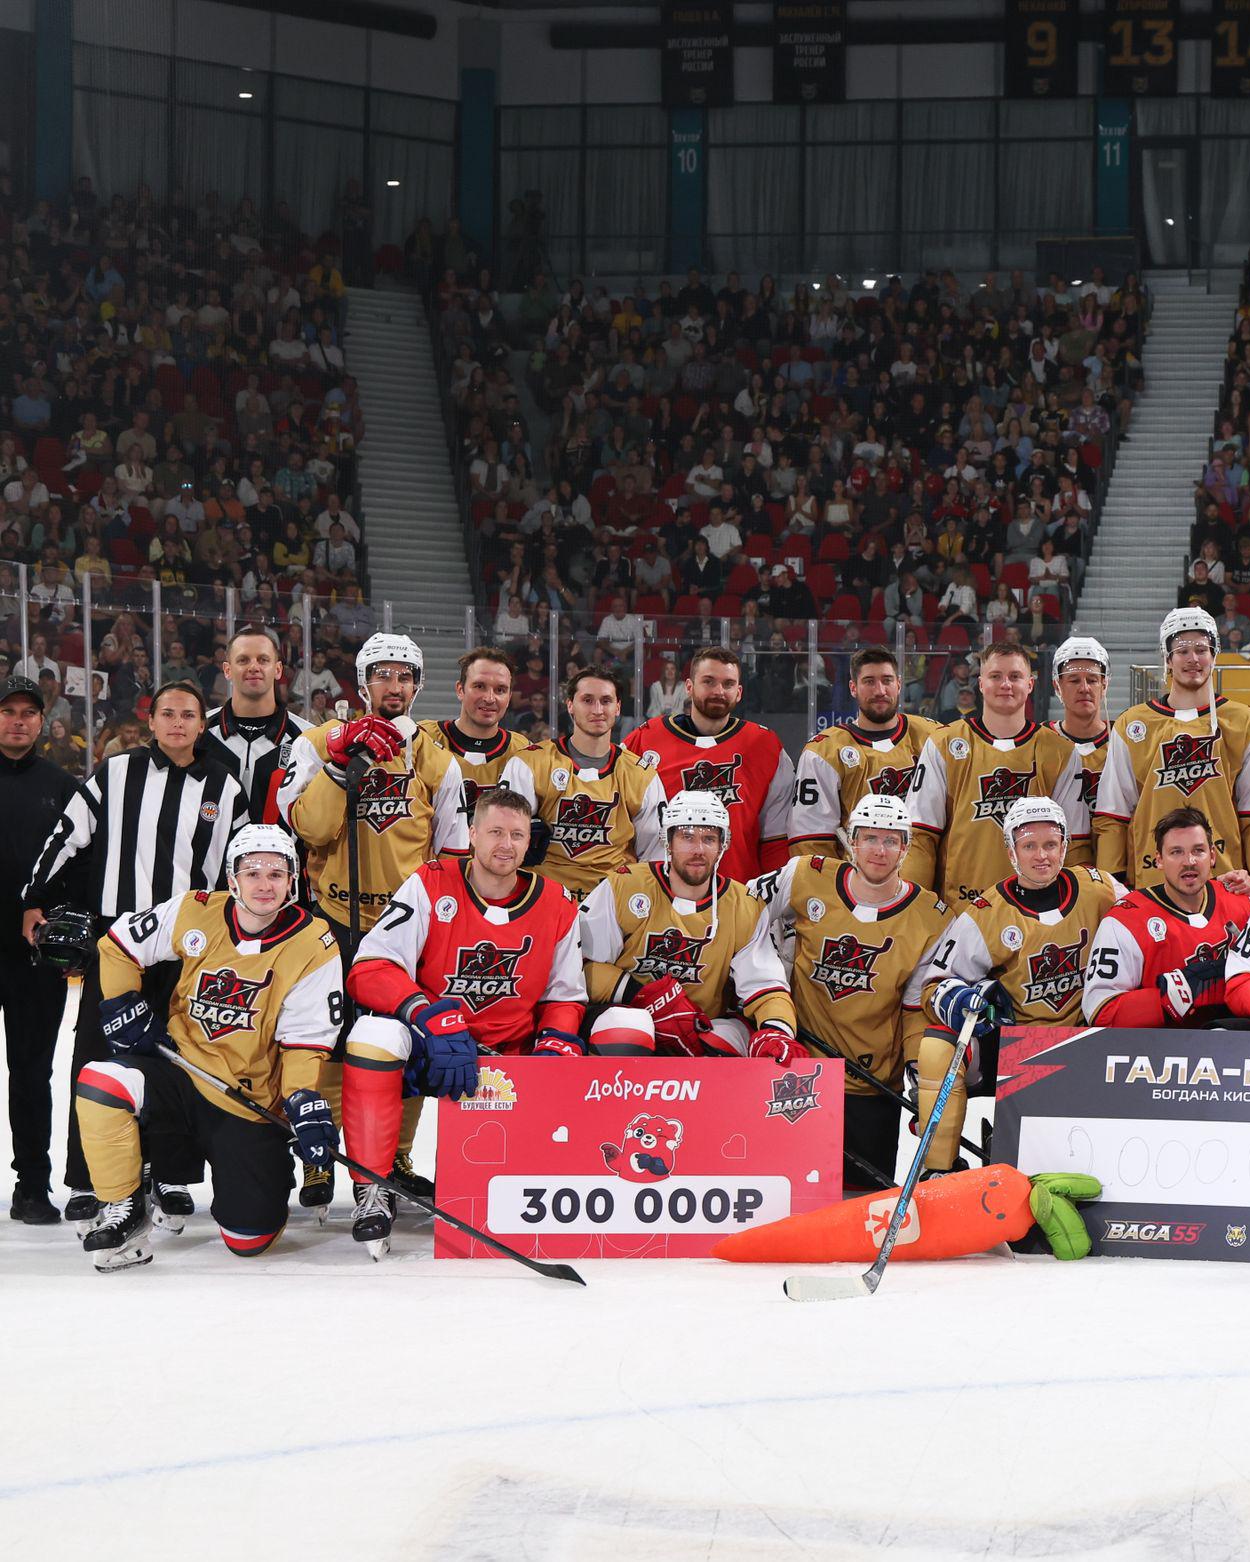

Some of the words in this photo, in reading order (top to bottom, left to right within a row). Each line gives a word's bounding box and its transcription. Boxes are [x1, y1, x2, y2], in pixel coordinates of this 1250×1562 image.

[667, 36, 729, 49] ЗАСЛУЖЕННЫЙ
[779, 31, 842, 44] ЗАСЛУЖЕННЫЙ
[1026, 20, 1059, 68] 9
[1108, 19, 1175, 67] 13
[682, 49, 713, 60] ТРЕНЕР
[795, 45, 825, 56] ТРЕНЕР
[681, 60, 714, 72] РОССИИ
[793, 56, 827, 68] РОССИИ
[677, 148, 697, 174] 10
[1103, 142, 1121, 167] 11
[1162, 762, 1214, 781] BAGA
[357, 801, 408, 817] BAGA
[550, 826, 604, 844] BAGA
[328, 882, 394, 906] Seerst
[638, 957, 702, 982] BAGA
[814, 967, 870, 989] BAGA
[452, 979, 514, 995] BAGA
[1028, 974, 1085, 1000] BAGA
[191, 1002, 251, 1028] BAGA
[210, 1022, 220, 1030] 55
[1152, 1088, 1220, 1102] БОГДАНА
[462, 1101, 492, 1112] БУДУЩЕЕ
[494, 1101, 514, 1111] ЕСТЬ!
[771, 1096, 815, 1114] BAGA
[520, 1187, 614, 1224] 300
[633, 1187, 764, 1224] 000₽
[1106, 1223, 1171, 1241] BAGA
[1171, 1225, 1200, 1242] 55
